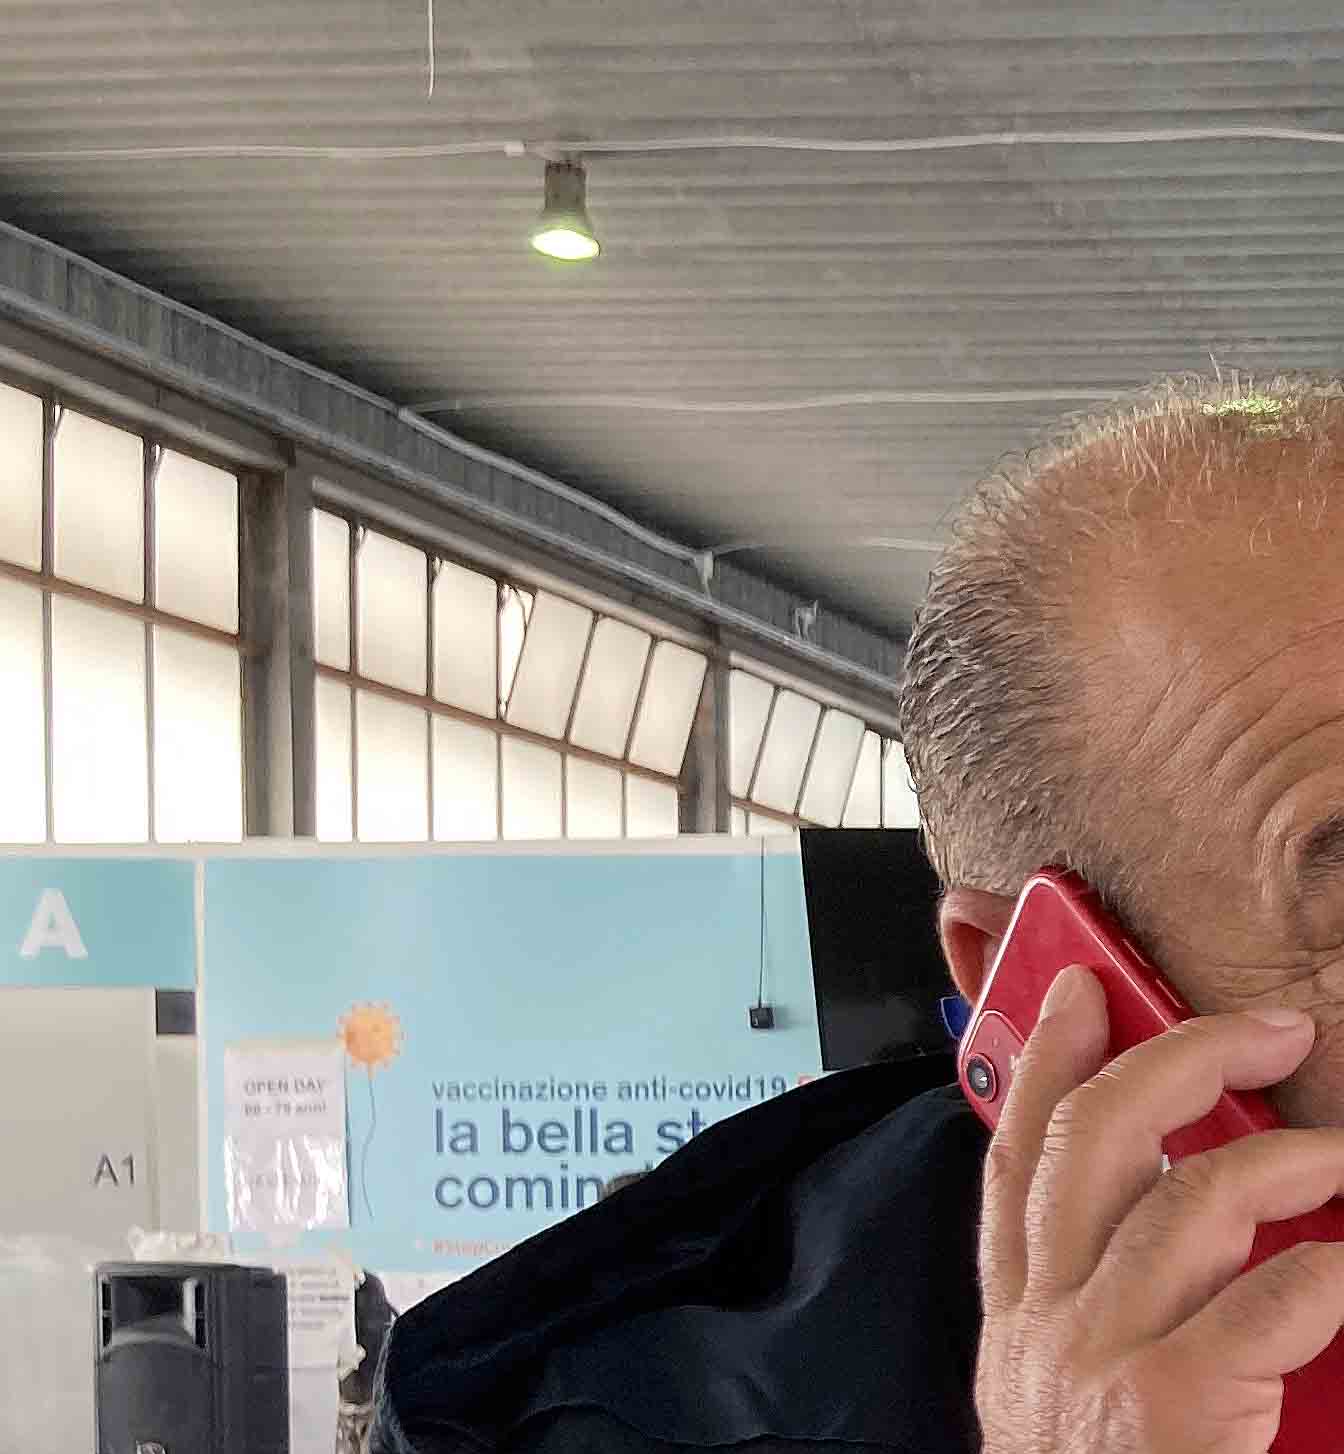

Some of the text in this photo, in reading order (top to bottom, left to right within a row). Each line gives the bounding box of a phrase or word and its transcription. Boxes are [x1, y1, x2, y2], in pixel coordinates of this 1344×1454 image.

[18, 887, 88, 960] A
[244, 1078, 327, 1096] OPEN DAY
[432, 1076, 607, 1101] vaccinazione
[616, 1075, 786, 1101] anti-covid19
[435, 1107, 480, 1154] la
[502, 1107, 634, 1155] bella
[94, 1153, 135, 1187] A1
[435, 1161, 654, 1209] comin
